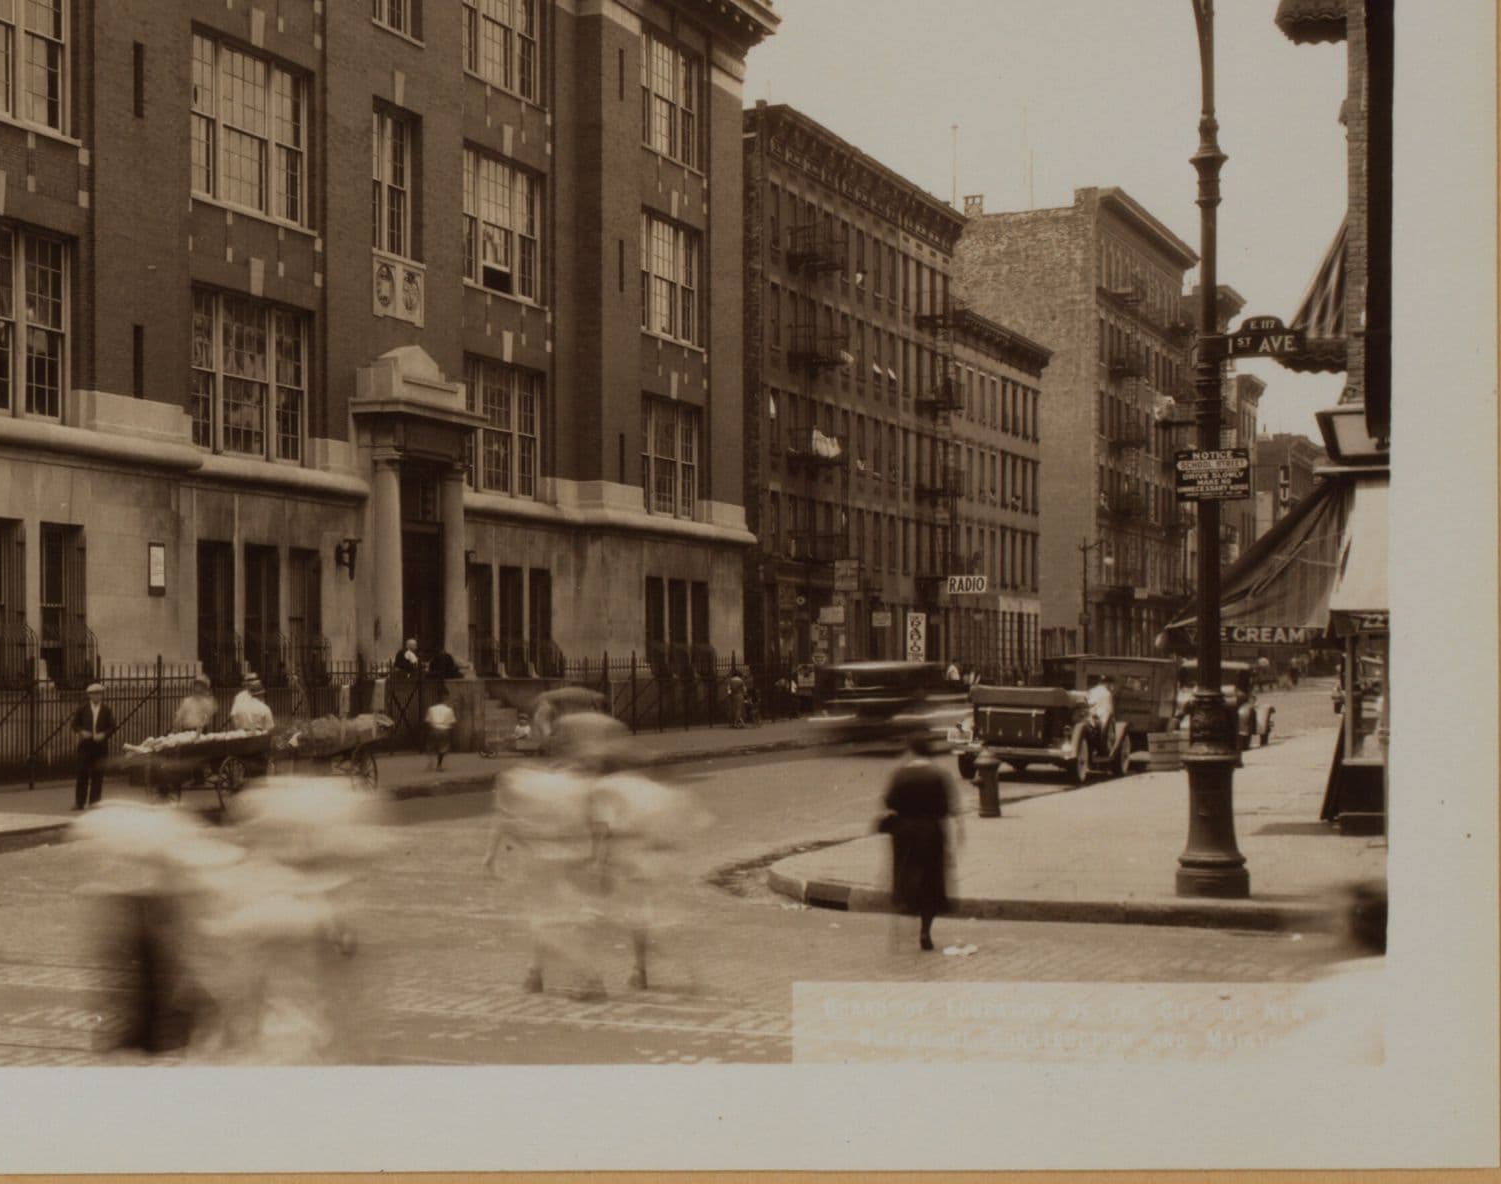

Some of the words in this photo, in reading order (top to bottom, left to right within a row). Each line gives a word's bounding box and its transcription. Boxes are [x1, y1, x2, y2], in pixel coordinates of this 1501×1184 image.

[1261, 319, 1276, 329] 117
[1192, 450, 1234, 461] NOTICE
[1182, 472, 1209, 480] DRIVE
[1211, 471, 1244, 479] SLOWLY
[1177, 485, 1228, 493] UNNECESSARY
[949, 577, 985, 592] RADIO
[1232, 627, 1306, 643] CREAM
